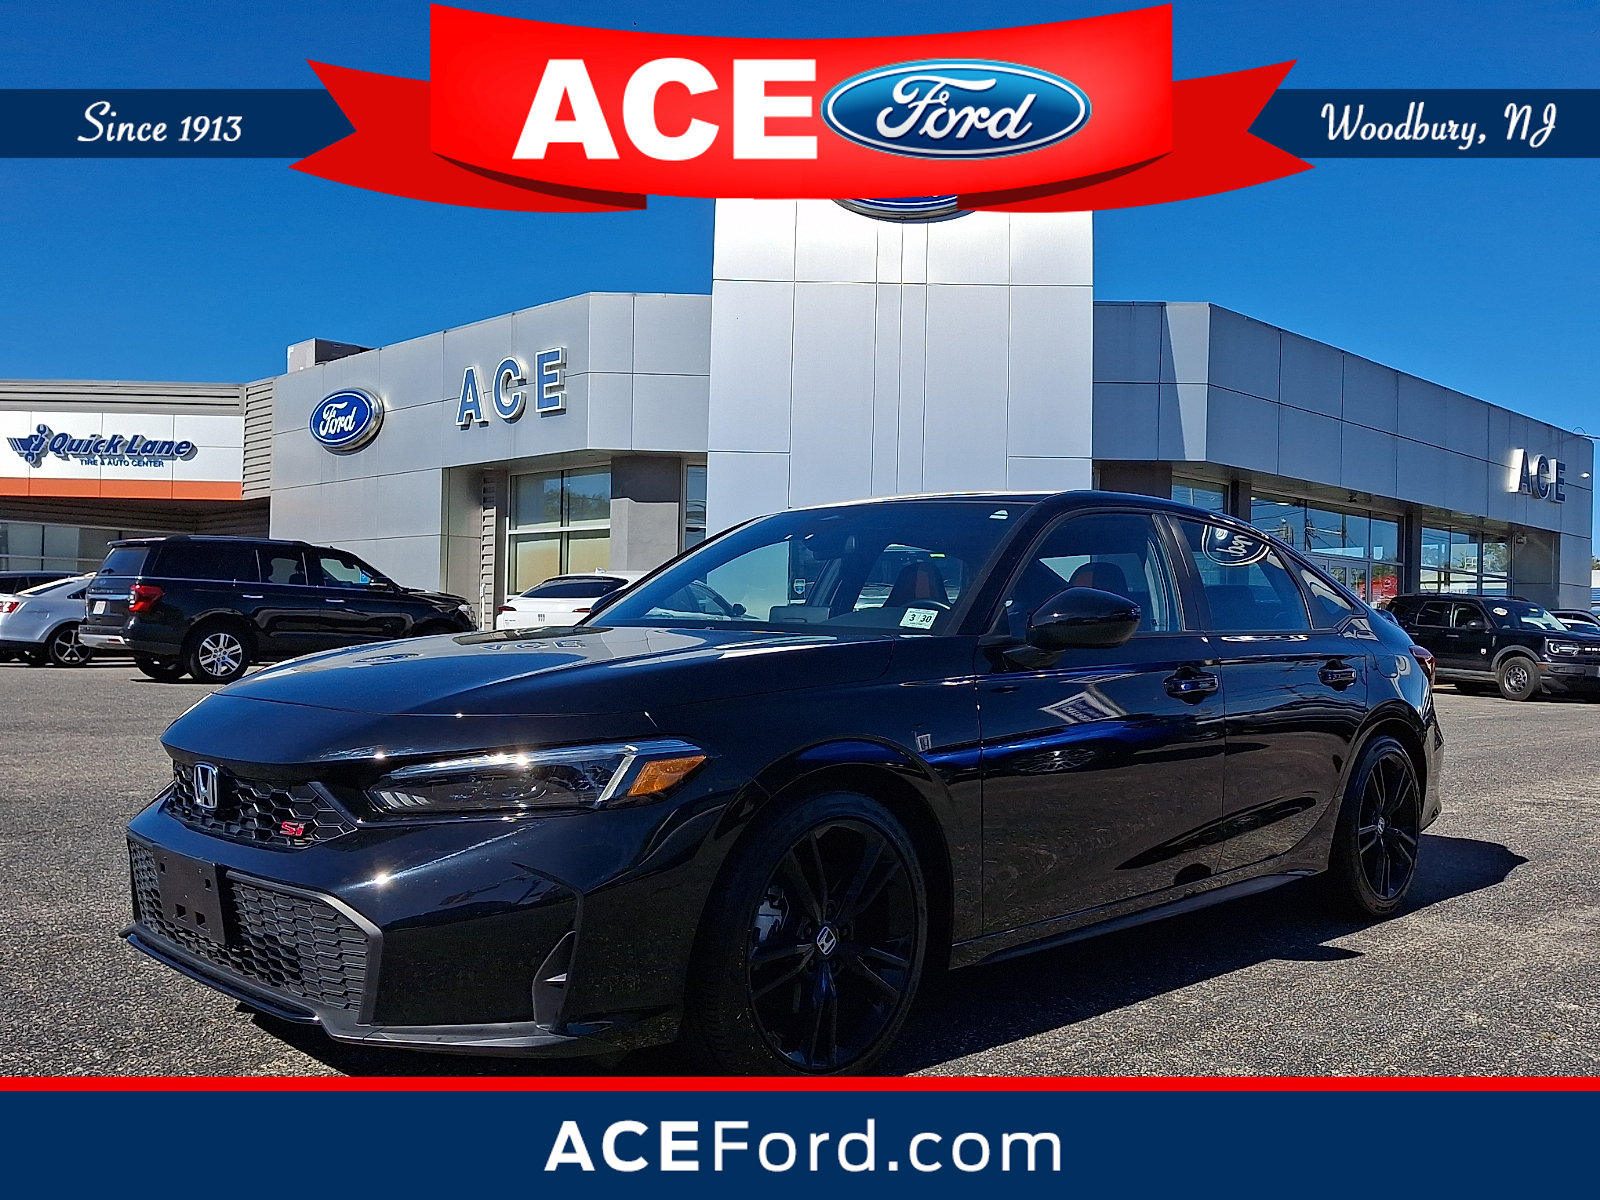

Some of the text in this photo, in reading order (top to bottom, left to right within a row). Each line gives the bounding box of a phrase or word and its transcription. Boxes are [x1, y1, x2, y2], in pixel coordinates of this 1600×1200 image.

[456, 347, 567, 430] ACE
[319, 401, 357, 436] Ford
[49, 432, 194, 457] Quick Lane
[80, 457, 98, 466] TIRE
[107, 458, 130, 467] AUTO
[132, 459, 164, 468] CENTER
[1508, 448, 1567, 503] ACE
[909, 613, 933, 623] 3 30
